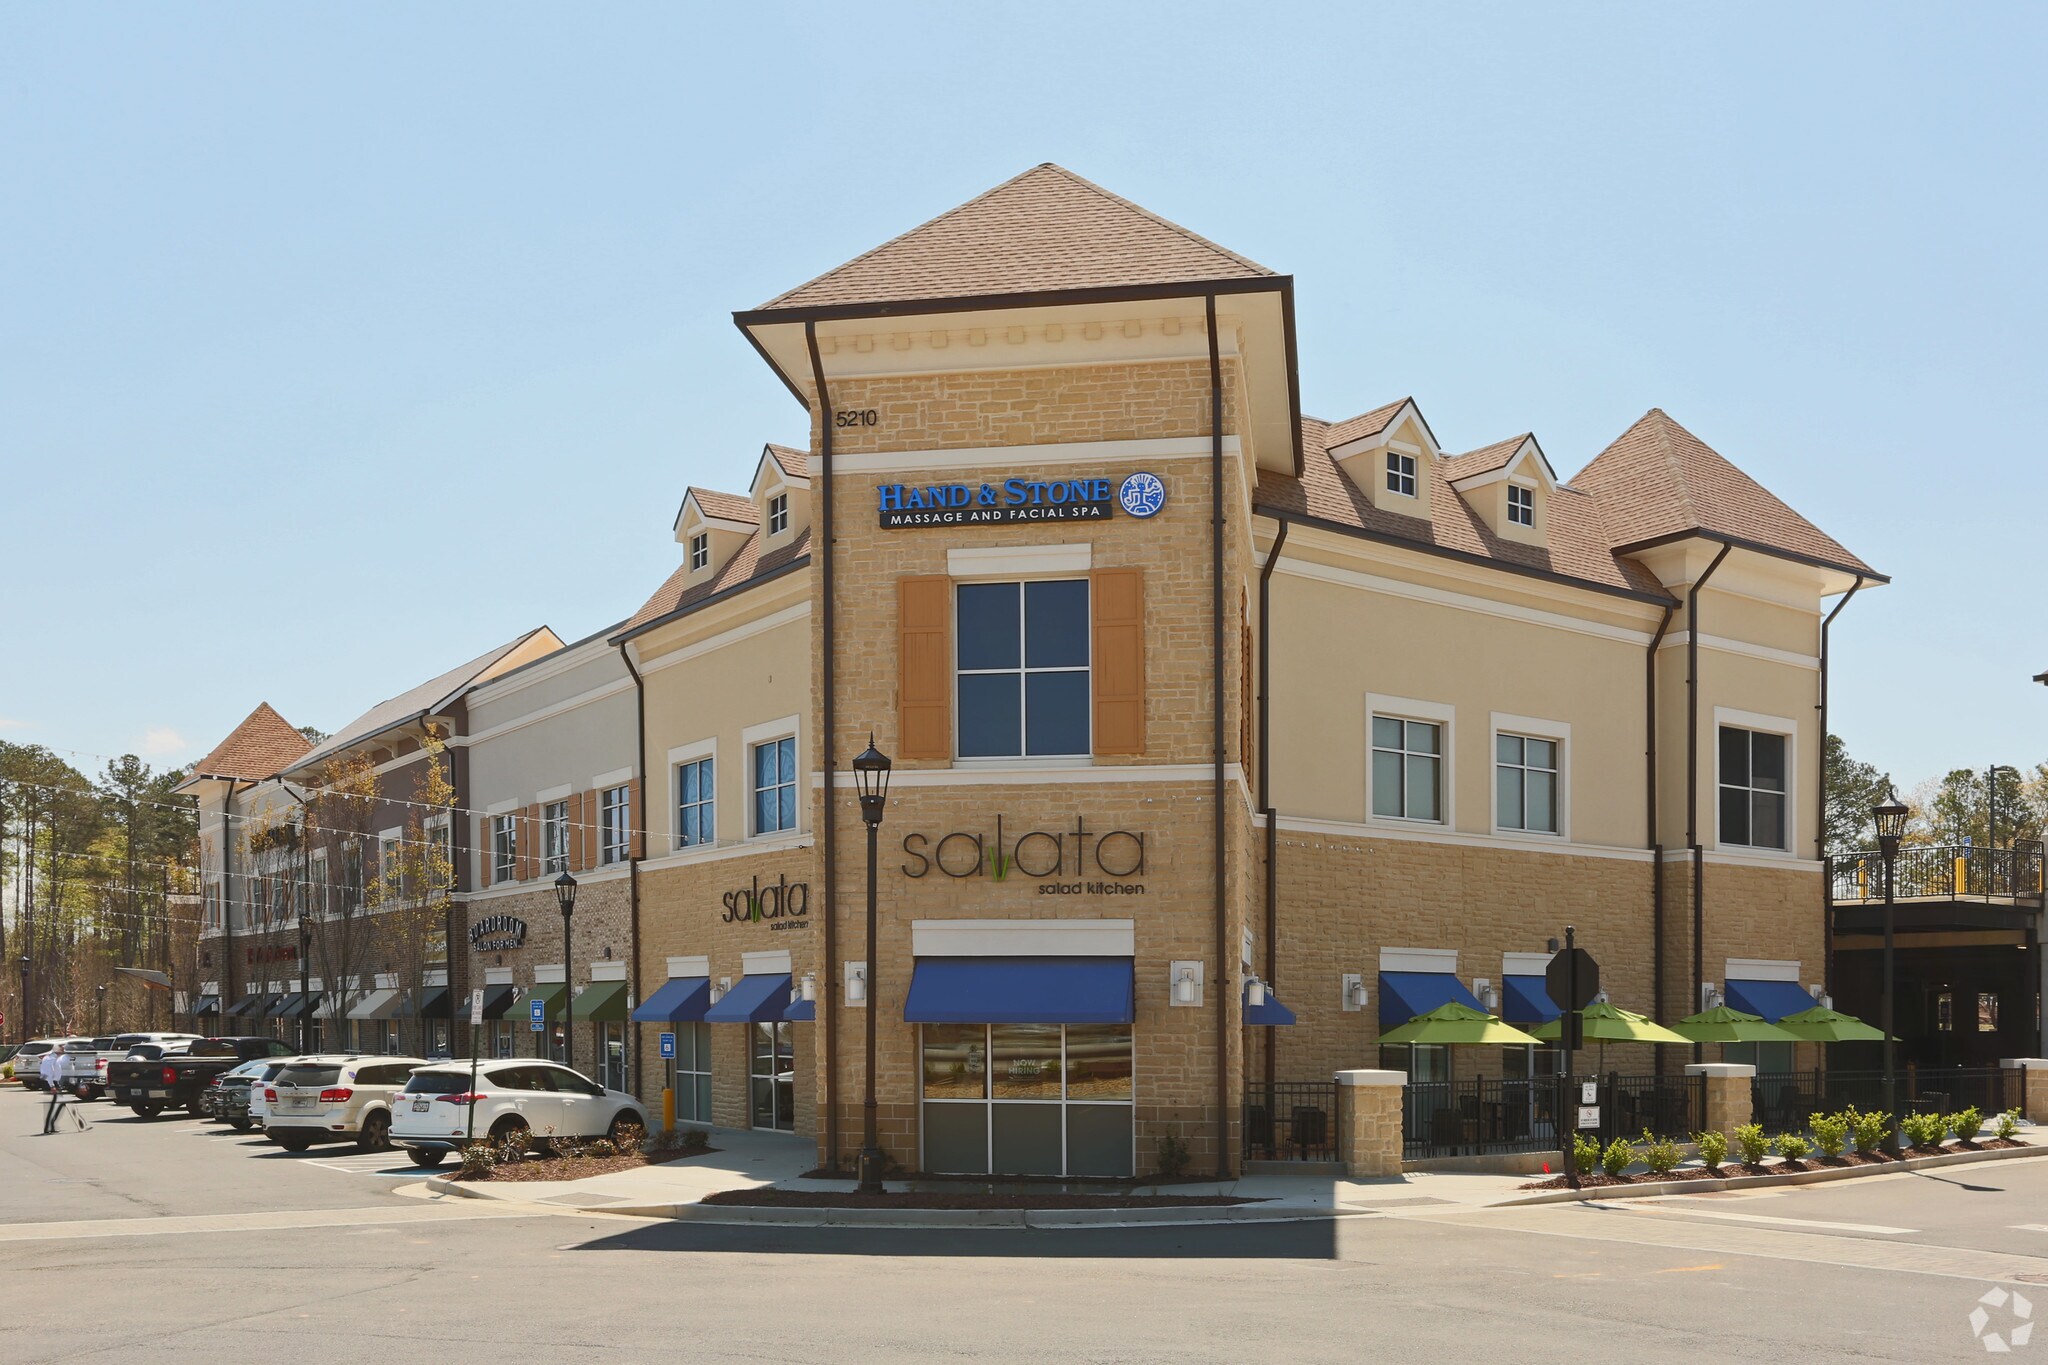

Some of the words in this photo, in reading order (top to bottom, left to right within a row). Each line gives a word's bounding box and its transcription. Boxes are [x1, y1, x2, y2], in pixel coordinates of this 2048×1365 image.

[836, 410, 878, 428] 5210
[877, 484, 972, 512] HAND
[977, 483, 997, 507] &
[1003, 478, 1112, 506] STONE
[890, 512, 963, 525] MASSAGE
[970, 510, 1002, 521] AND
[1010, 507, 1065, 520] FACIAL
[1072, 506, 1101, 517] SPA
[901, 814, 1145, 882] salata
[1038, 881, 1082, 895] salad
[1086, 881, 1145, 895] kitchen
[721, 873, 808, 924] salata
[468, 915, 523, 943] BOARDROOM
[770, 920, 788, 931] salad
[788, 919, 809, 930] kitchen
[473, 941, 492, 952] SALON
[492, 939, 505, 951] FOR
[505, 938, 518, 950] MEN
[1008, 1067, 1041, 1075] HIRING
[1013, 1059, 1036, 1067] NOW
